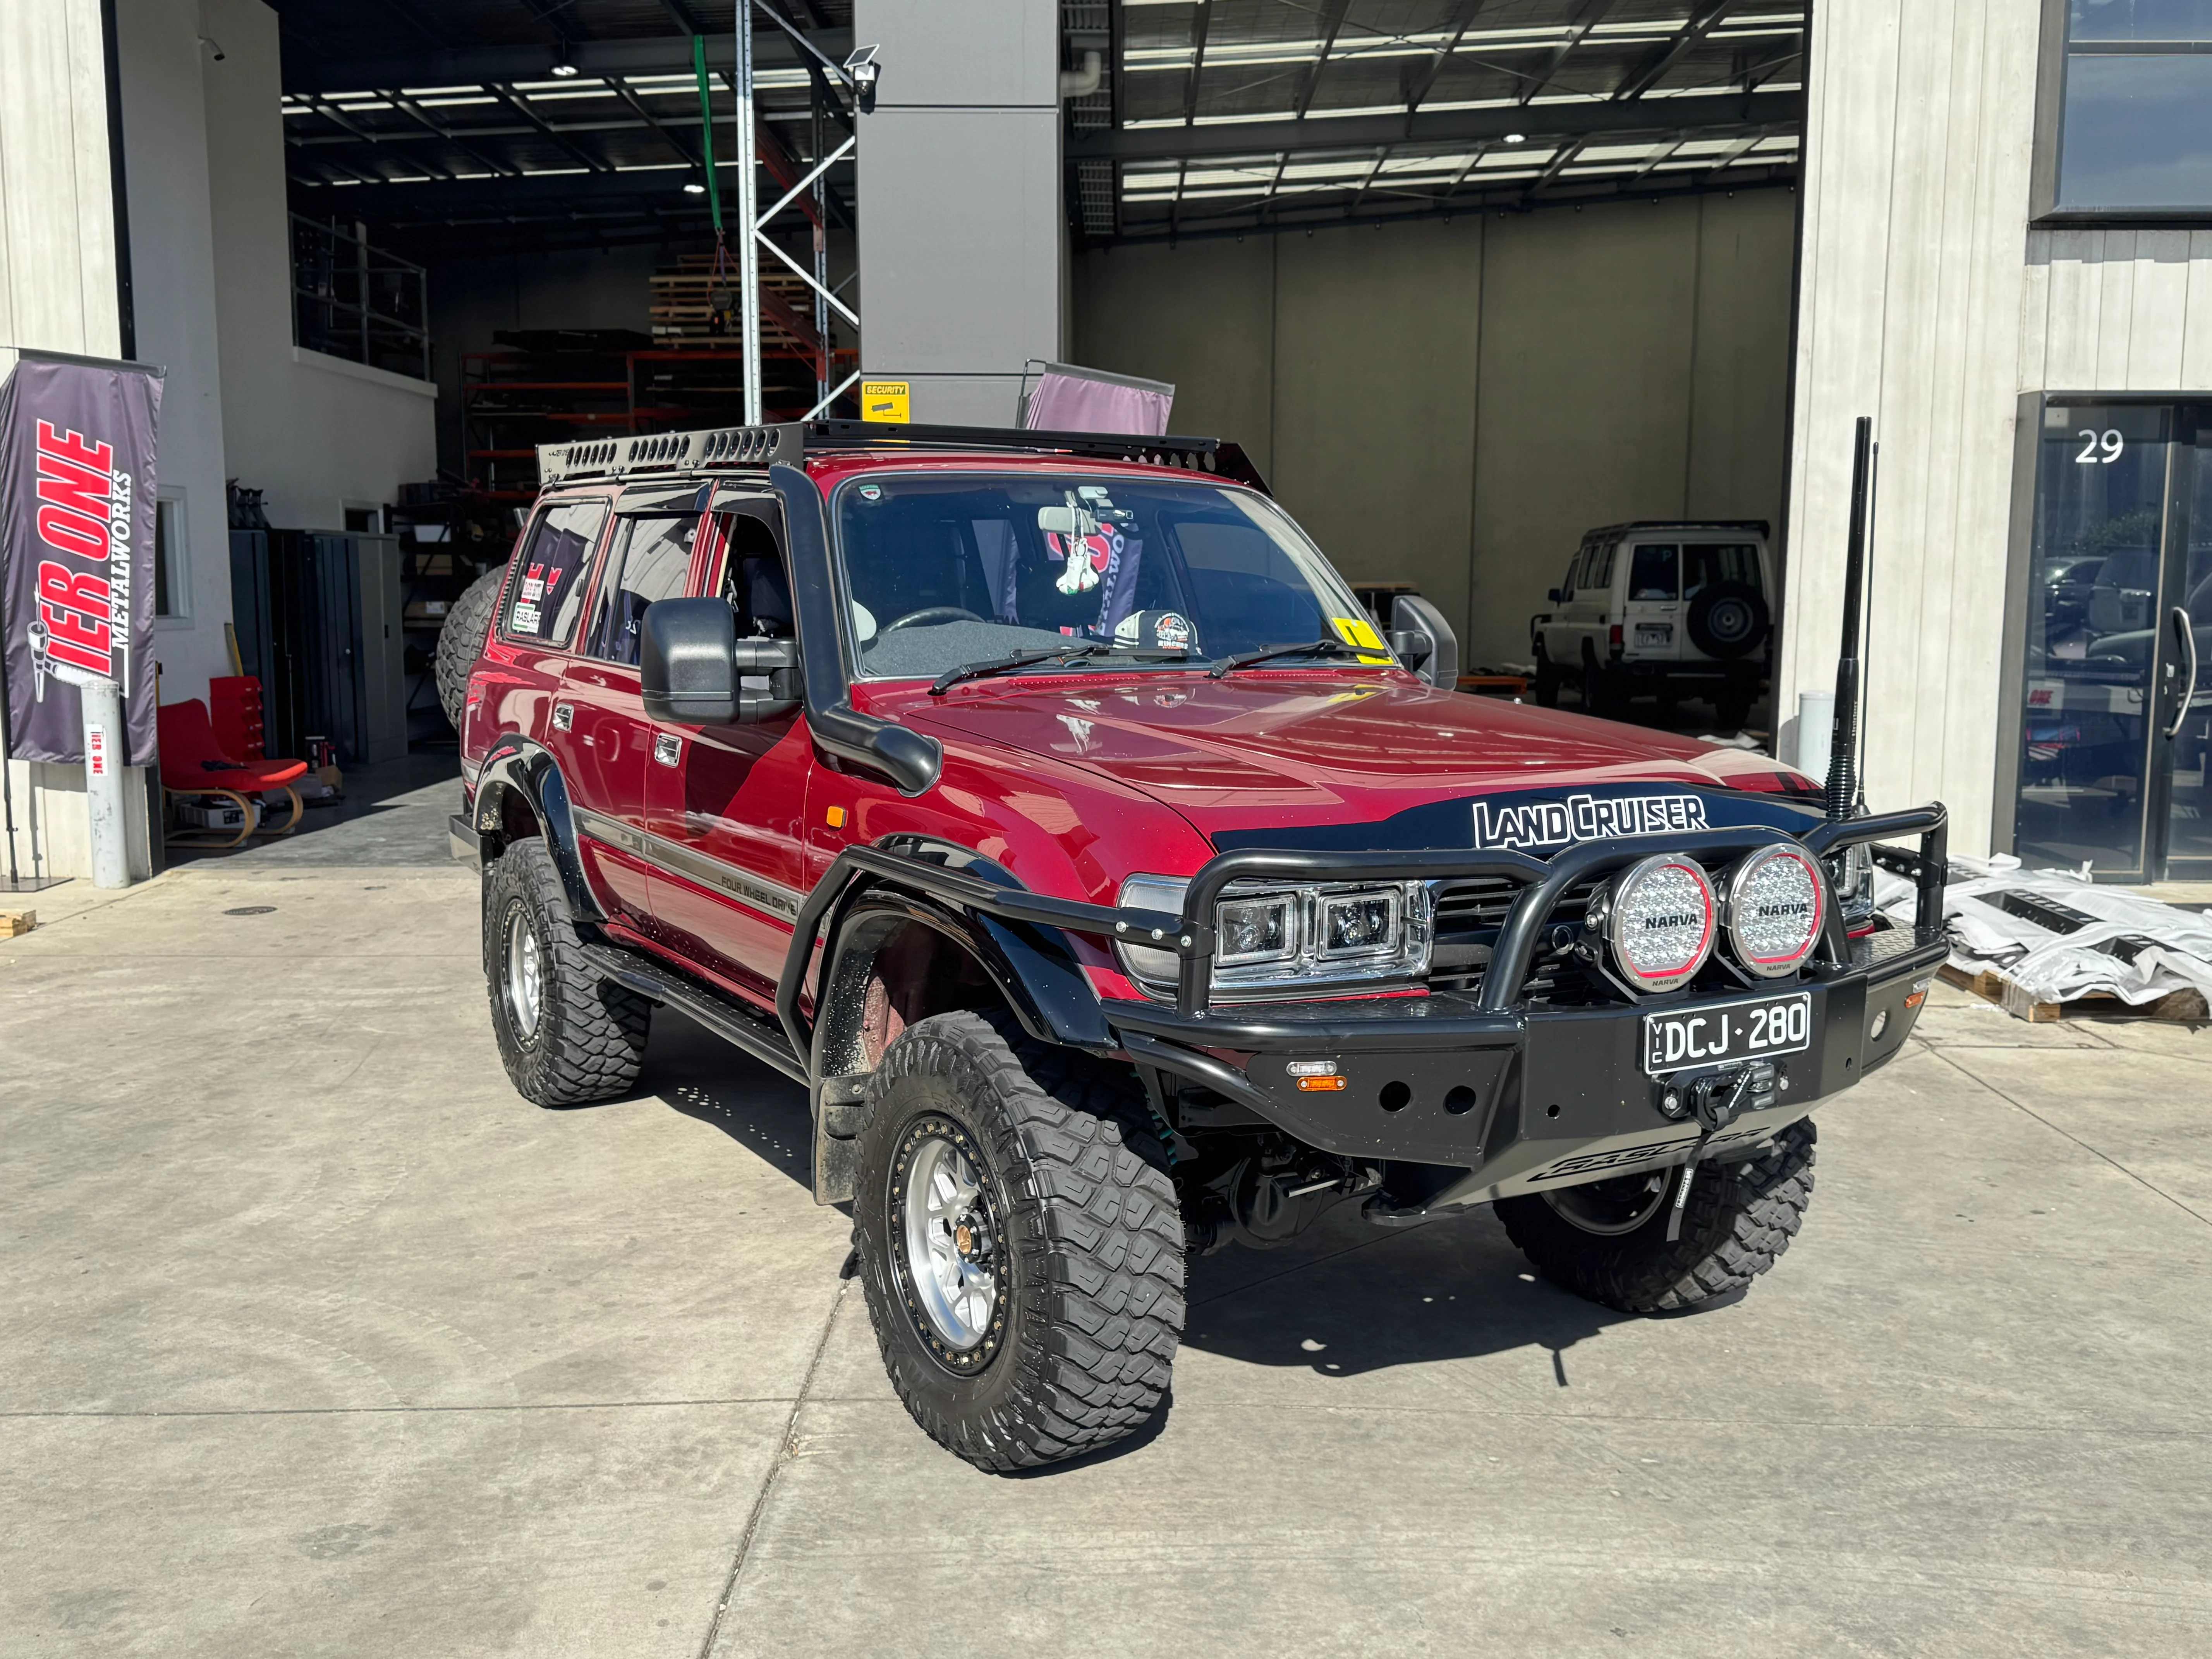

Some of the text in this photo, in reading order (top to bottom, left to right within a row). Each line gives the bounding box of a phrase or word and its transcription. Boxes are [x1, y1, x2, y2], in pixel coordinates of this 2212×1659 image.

[867, 386, 904, 394] SECURITY
[2076, 429, 2123, 463] 29
[37, 418, 113, 562] ONE
[111, 469, 132, 649] METALWORKS
[92, 756, 103, 774] ONE
[1473, 794, 1710, 849] LANDCRUISER
[722, 876, 742, 894] FOUR
[744, 885, 771, 906] WHEEL
[1646, 914, 1697, 929] NARVA
[1759, 903, 1807, 916] NARVA
[1766, 963, 1791, 972] NARVA
[1652, 978, 1680, 986] NARVA
[1652, 1023, 1662, 1063] VIC
